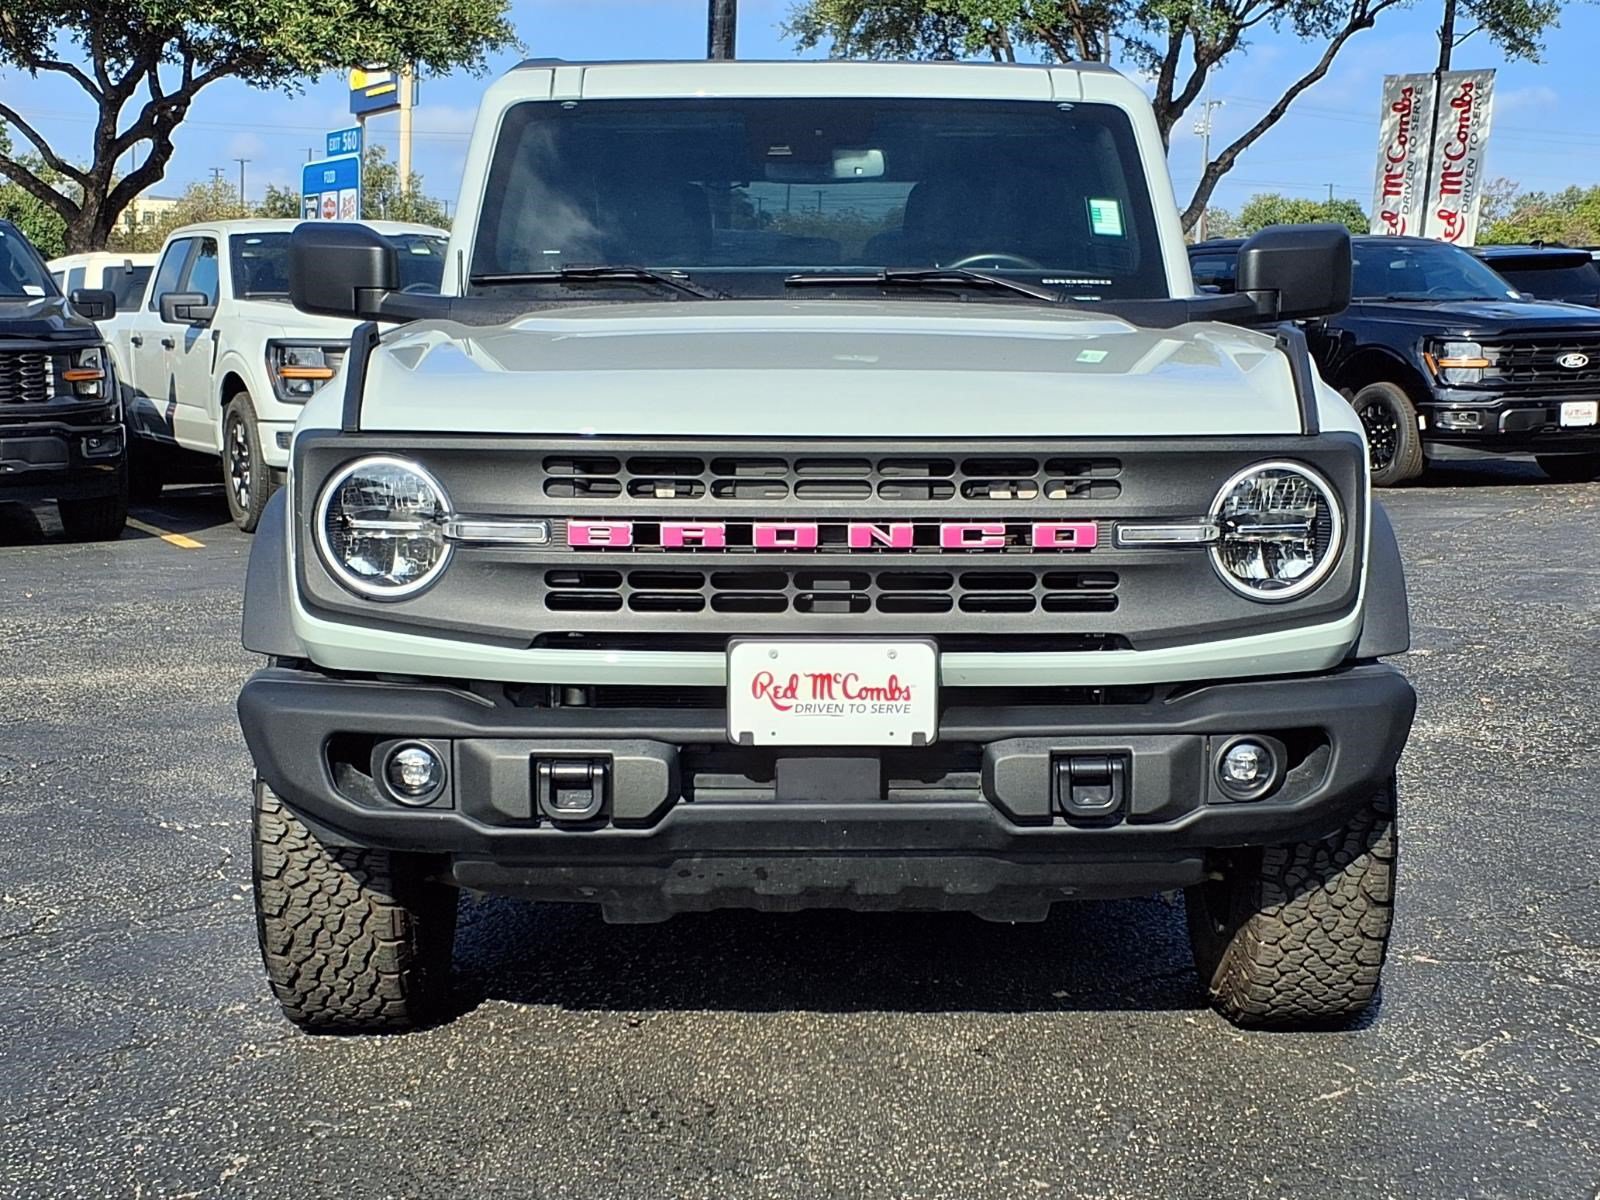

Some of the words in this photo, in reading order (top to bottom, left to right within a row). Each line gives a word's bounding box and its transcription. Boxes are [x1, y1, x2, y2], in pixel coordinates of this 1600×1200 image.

[1411, 86, 1424, 132] SERVE
[1472, 80, 1485, 129] SERVE
[329, 137, 341, 151] EXIT
[342, 131, 357, 151] 560
[1381, 87, 1413, 205] McCombs
[1407, 135, 1417, 155] TO
[1438, 82, 1474, 205] McCombs
[1469, 132, 1479, 152] TO
[1402, 160, 1415, 215] DRIVEN
[1461, 158, 1476, 214] DRIVEN
[1381, 210, 1406, 236] ed
[1436, 209, 1465, 243] ed
[567, 521, 1098, 548] BRONCO
[751, 671, 800, 712] Red
[804, 672, 912, 702] McCombs
[794, 703, 844, 714] DRIVEN
[848, 703, 867, 714] TO
[870, 703, 912, 714] SERVE
